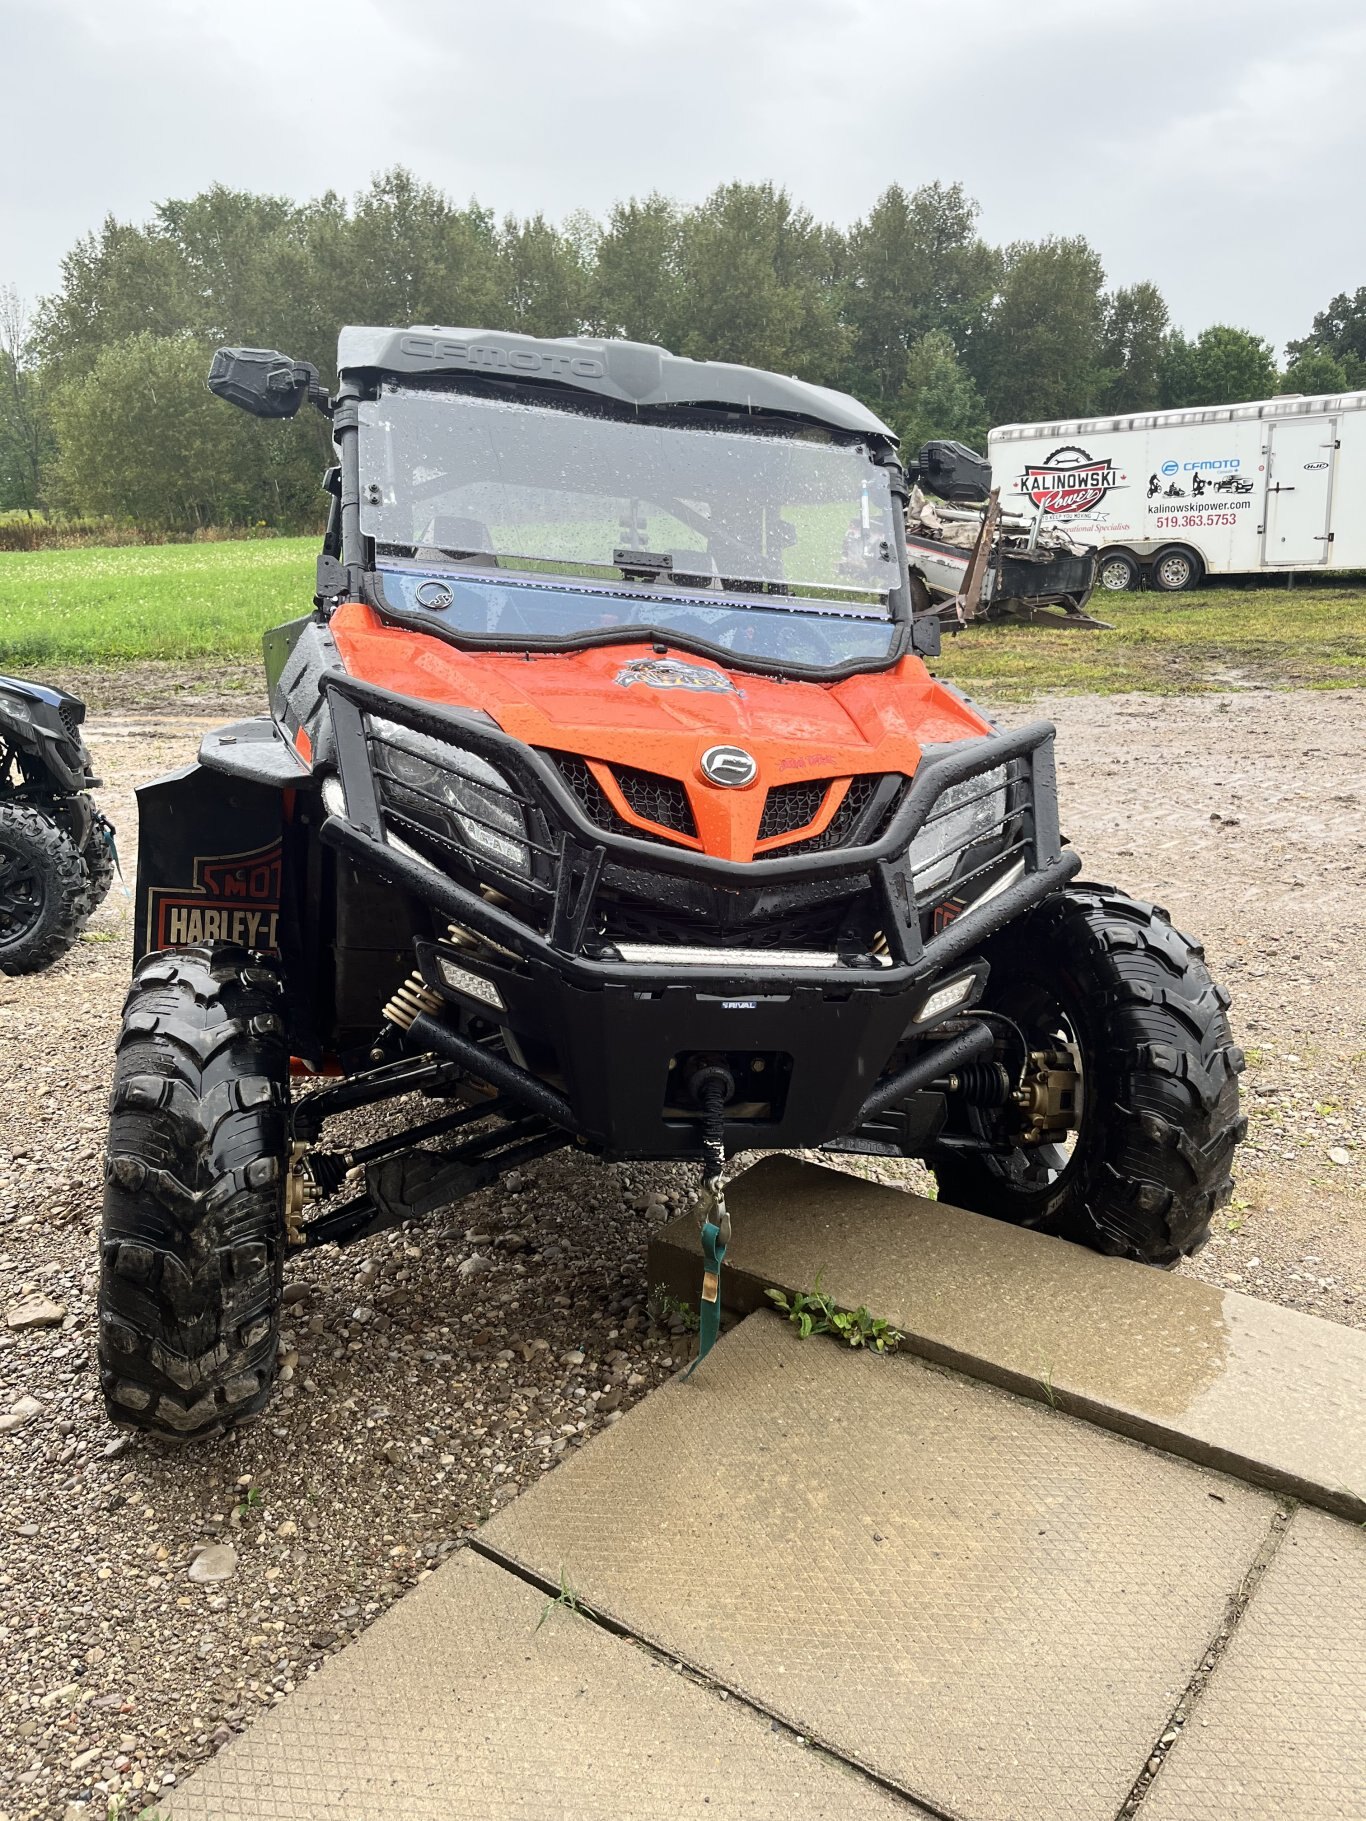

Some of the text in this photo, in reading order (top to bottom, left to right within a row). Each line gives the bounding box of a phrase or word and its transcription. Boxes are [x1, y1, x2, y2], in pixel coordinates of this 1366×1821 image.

[400, 336, 604, 379] CFMOTO
[1183, 459, 1240, 471] CFMOTO
[1020, 470, 1116, 492] KALINOWSKI
[1044, 488, 1100, 509] Power
[1148, 500, 1251, 514] kalinowskipower.com
[1156, 513, 1237, 528] 519.363.5753
[1094, 523, 1131, 534] Specialists
[728, 1001, 756, 1009] RIVAL
